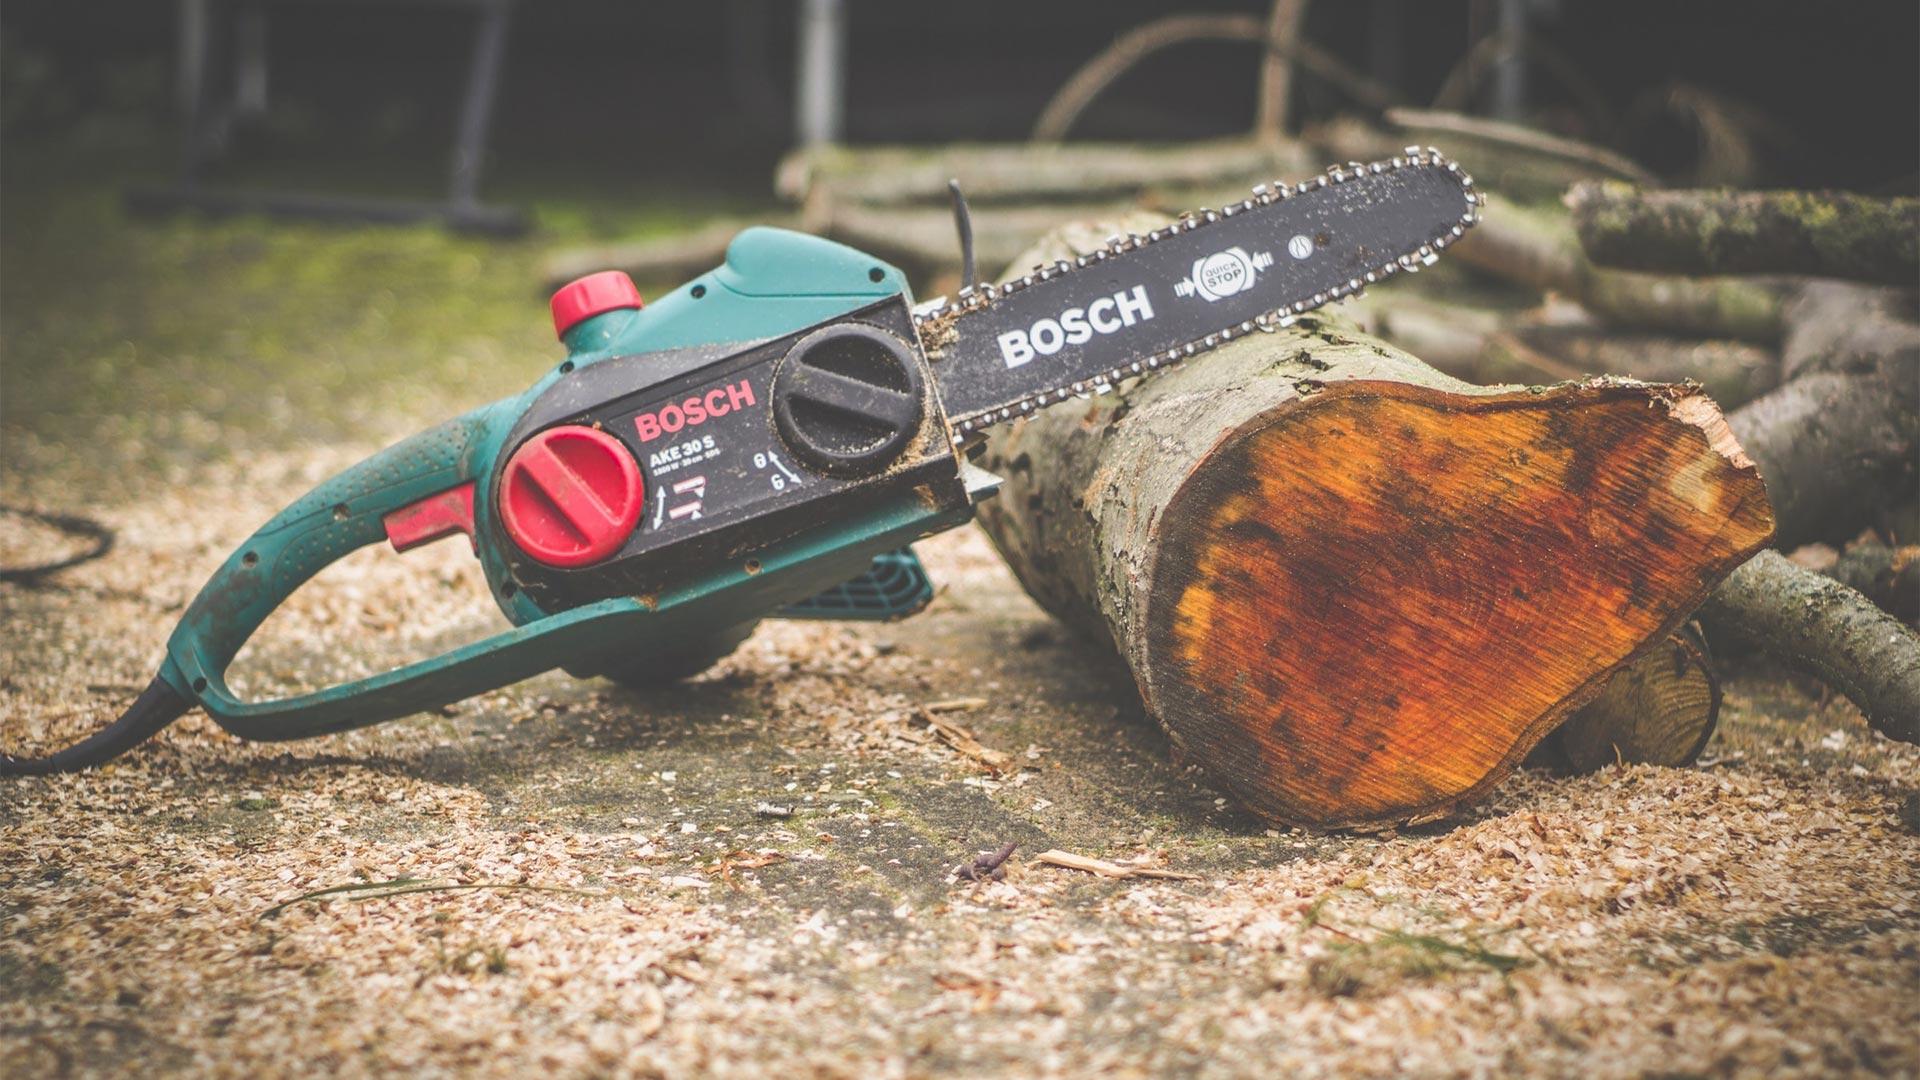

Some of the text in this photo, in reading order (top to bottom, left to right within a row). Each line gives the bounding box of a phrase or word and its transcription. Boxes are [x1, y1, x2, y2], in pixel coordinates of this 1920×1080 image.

[1206, 262, 1237, 277] QUICK
[1207, 270, 1242, 288] STOP
[998, 286, 1154, 369] BOSCH
[634, 379, 756, 442] BOSCH
[650, 435, 715, 467] AKE 30 S
